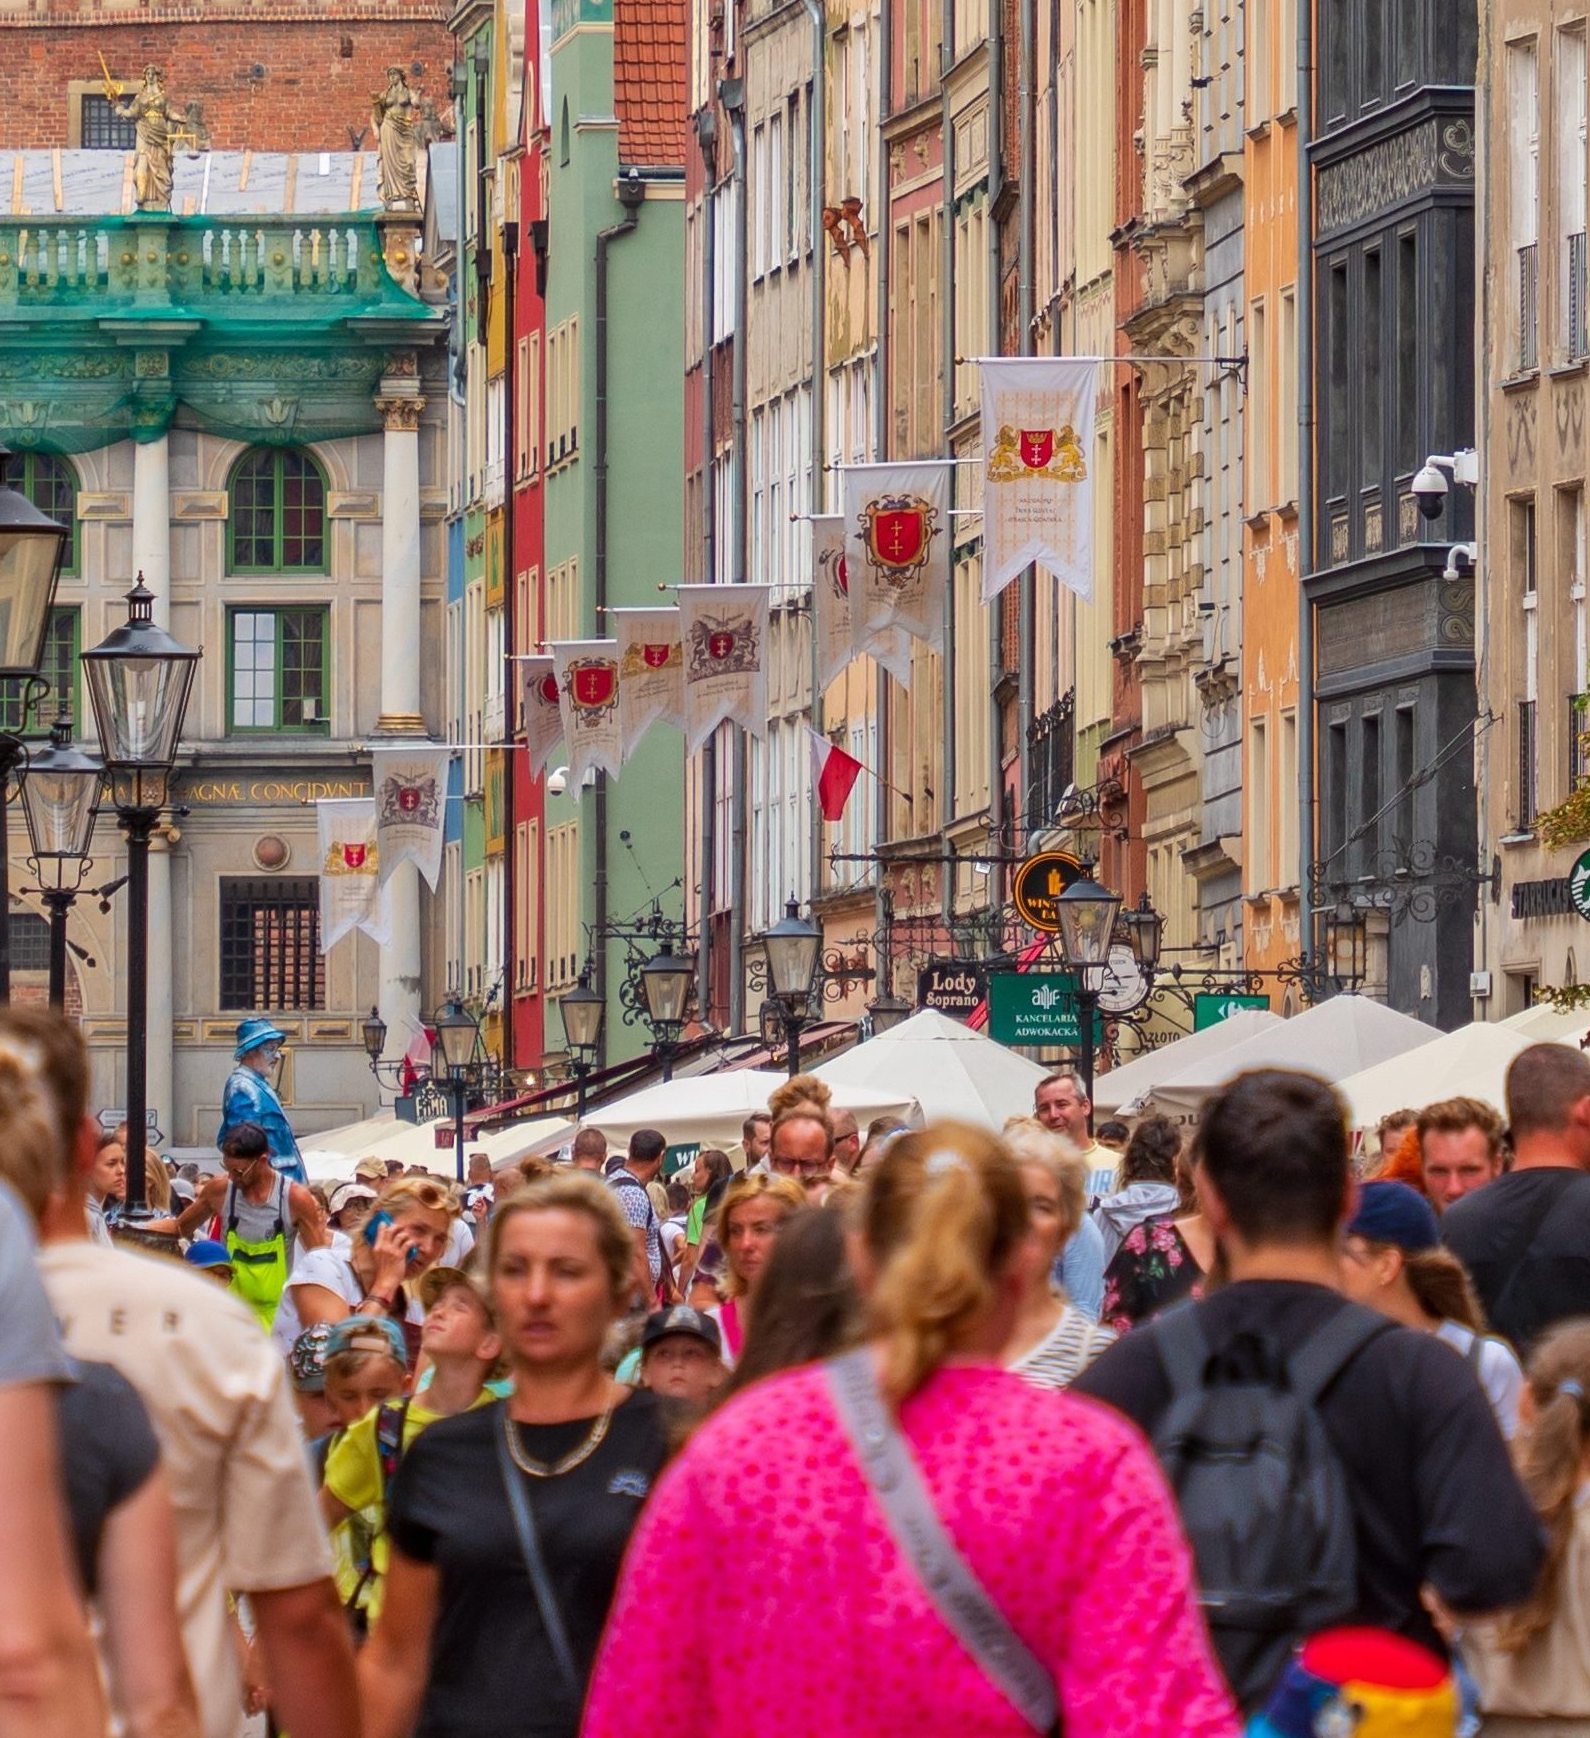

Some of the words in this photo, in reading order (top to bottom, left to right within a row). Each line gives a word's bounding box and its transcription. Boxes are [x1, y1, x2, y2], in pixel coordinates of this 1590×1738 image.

[931, 971, 977, 994] Lody
[925, 991, 979, 1009] Soprano
[1015, 1014, 1078, 1023] KANCELARIA
[1015, 1026, 1078, 1036] ADWOKACKA
